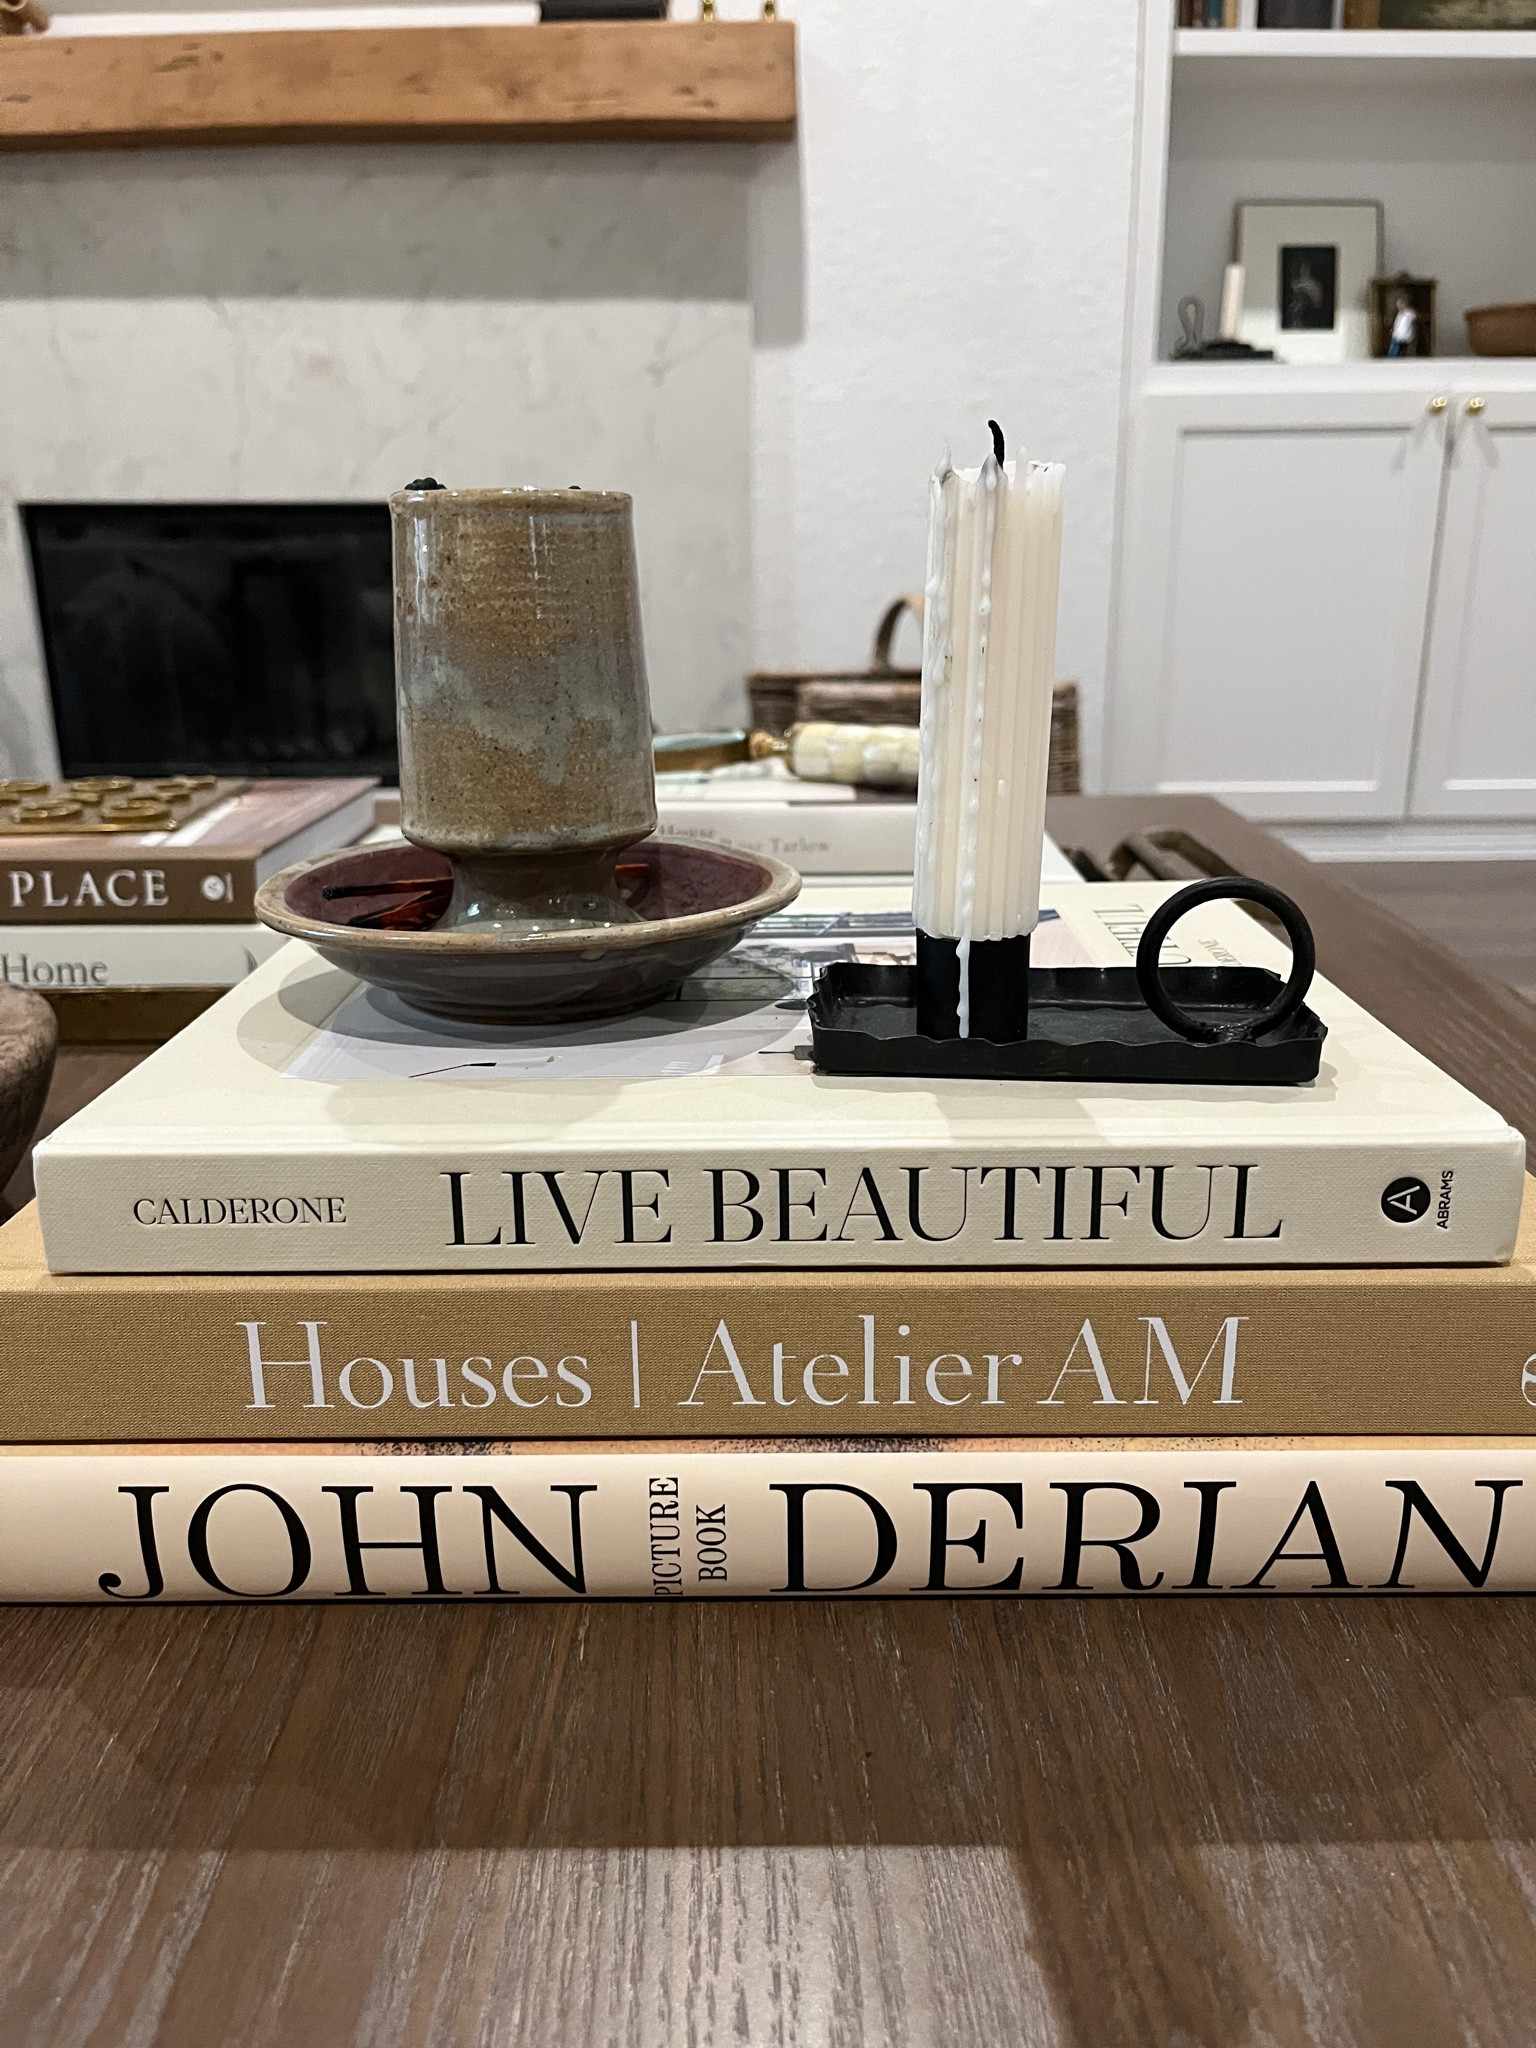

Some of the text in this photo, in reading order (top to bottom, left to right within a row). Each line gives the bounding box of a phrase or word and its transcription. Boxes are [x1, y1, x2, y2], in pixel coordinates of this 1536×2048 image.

[8, 869, 169, 907] PLACE
[0, 953, 108, 985] Home
[133, 1196, 347, 1226] CALDERONE
[441, 1164, 1284, 1246] LIVE BEAUTIFUL
[1437, 1170, 1454, 1229] ABRAMS
[236, 1320, 593, 1410] Houses
[677, 1315, 1023, 1407] Atelier
[1037, 1316, 1249, 1406] AM
[98, 1479, 1524, 1599] JOHN DERIAN
[649, 1477, 683, 1596] PICTURE
[696, 1504, 727, 1582] BOOK
